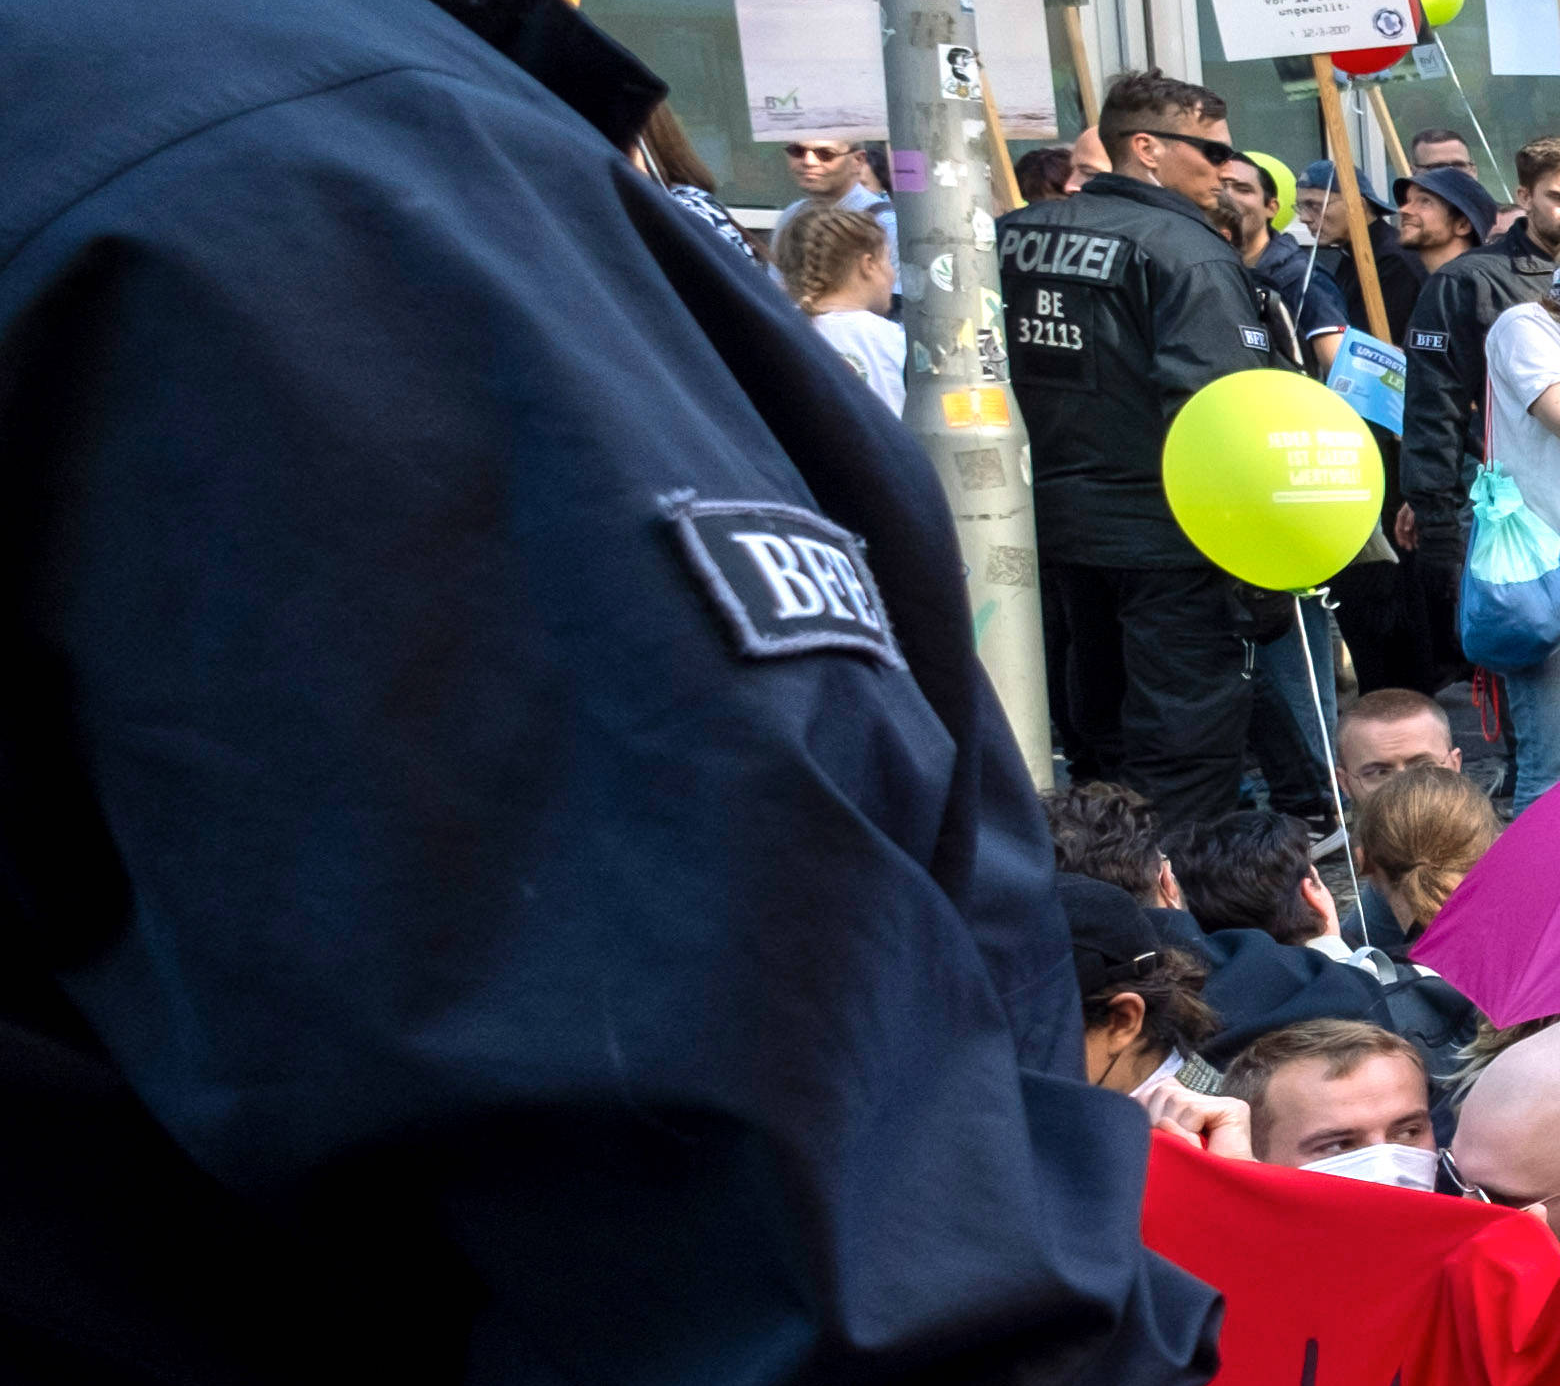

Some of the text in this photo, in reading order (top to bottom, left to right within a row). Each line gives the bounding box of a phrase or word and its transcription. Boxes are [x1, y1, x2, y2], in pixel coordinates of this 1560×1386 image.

[1001, 229, 1121, 281] POLIZEI
[1036, 289, 1065, 319] BE
[1018, 318, 1084, 351] 32113
[1416, 333, 1443, 348] BFE
[730, 532, 881, 630] BFE
